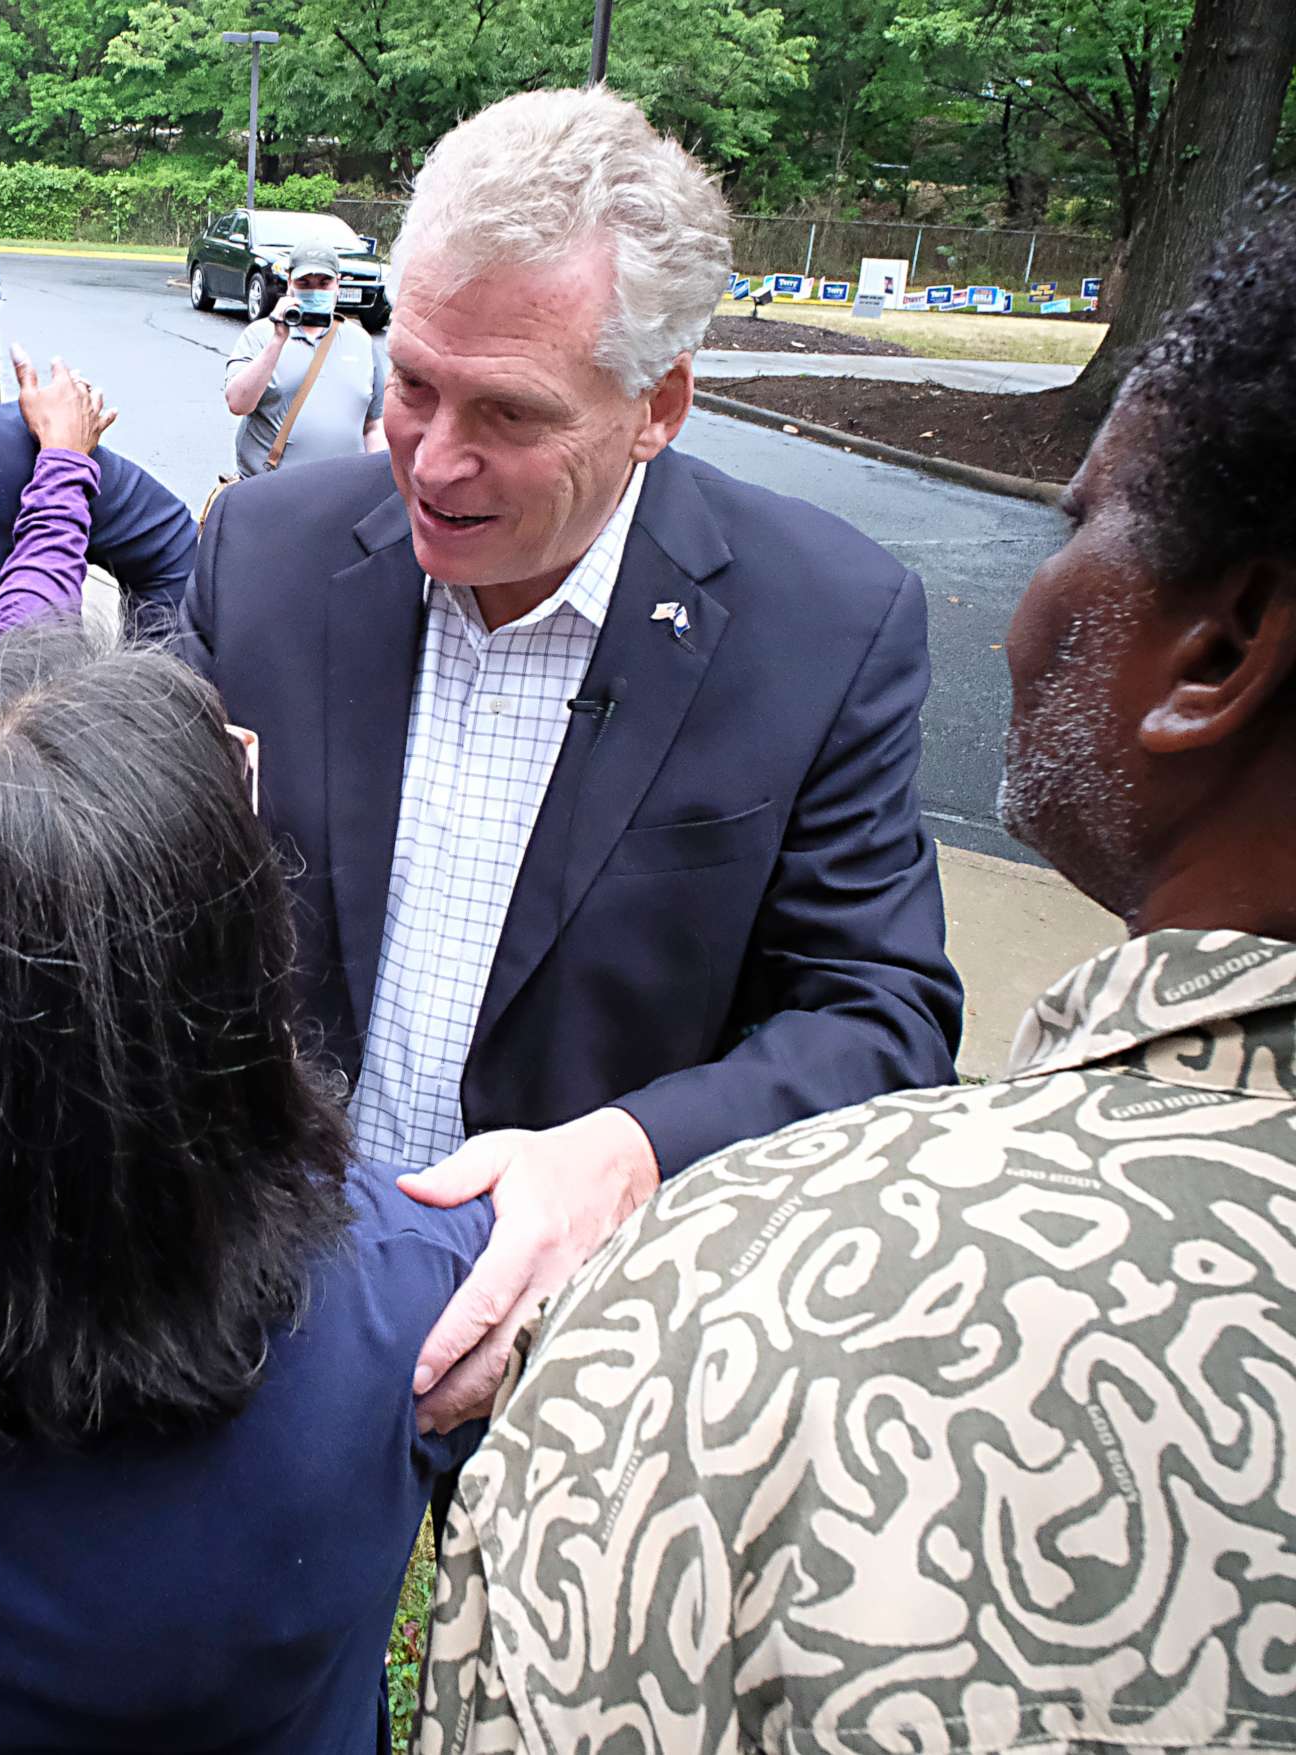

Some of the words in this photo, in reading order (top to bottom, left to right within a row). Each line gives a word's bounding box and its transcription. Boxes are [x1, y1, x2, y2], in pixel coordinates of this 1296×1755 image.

[1164, 973, 1211, 1003] GOD
[1209, 948, 1274, 981] BODY
[1110, 1099, 1164, 1119] GOD
